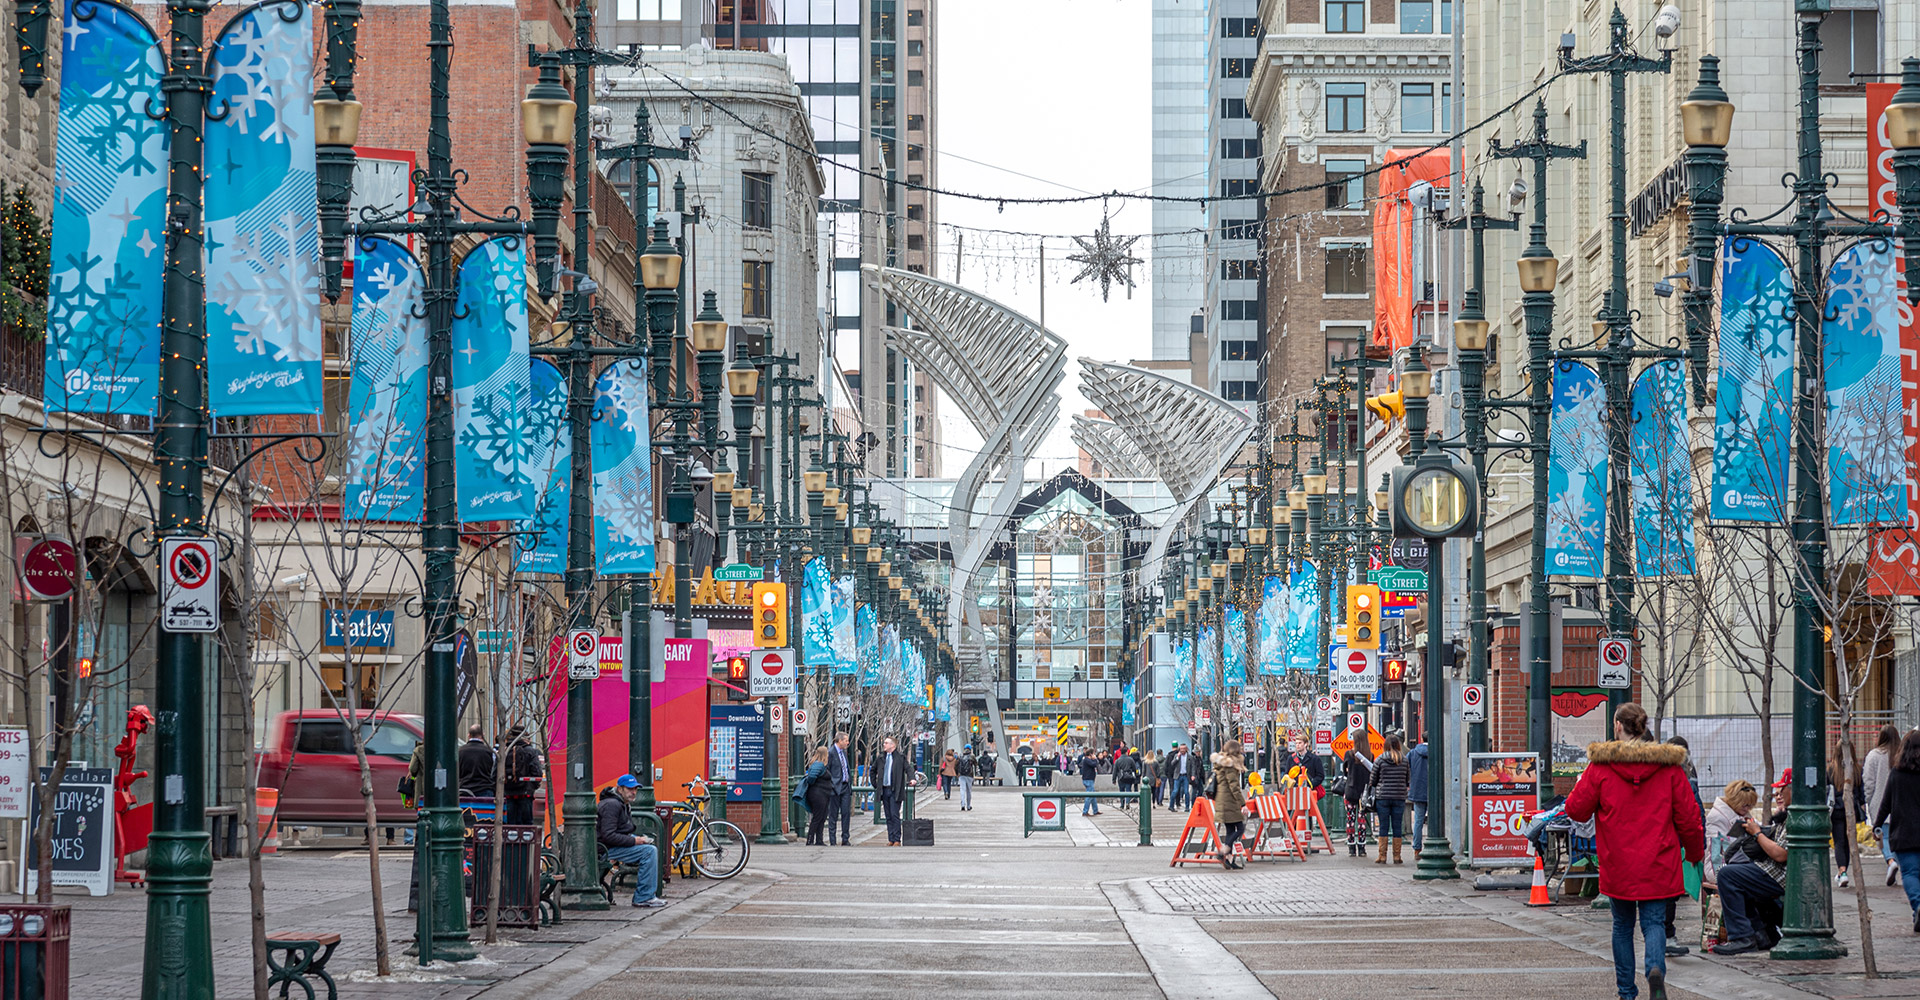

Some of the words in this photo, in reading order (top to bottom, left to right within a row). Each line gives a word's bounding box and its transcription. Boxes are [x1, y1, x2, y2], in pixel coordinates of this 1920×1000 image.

[274, 367, 305, 388] Walk
[92, 383, 127, 395] calgary
[725, 570, 746, 578] STREET
[749, 570, 760, 578] SW
[1384, 579, 1388, 587] 1
[1392, 579, 1419, 587] STREET
[1423, 579, 1428, 587] S
[329, 613, 392, 643] Hatley
[664, 644, 693, 661] GARY
[837, 707, 850, 719] 30
[63, 773, 106, 782] cellar
[1484, 800, 1525, 812] SAVE
[1479, 812, 1526, 836] $50
